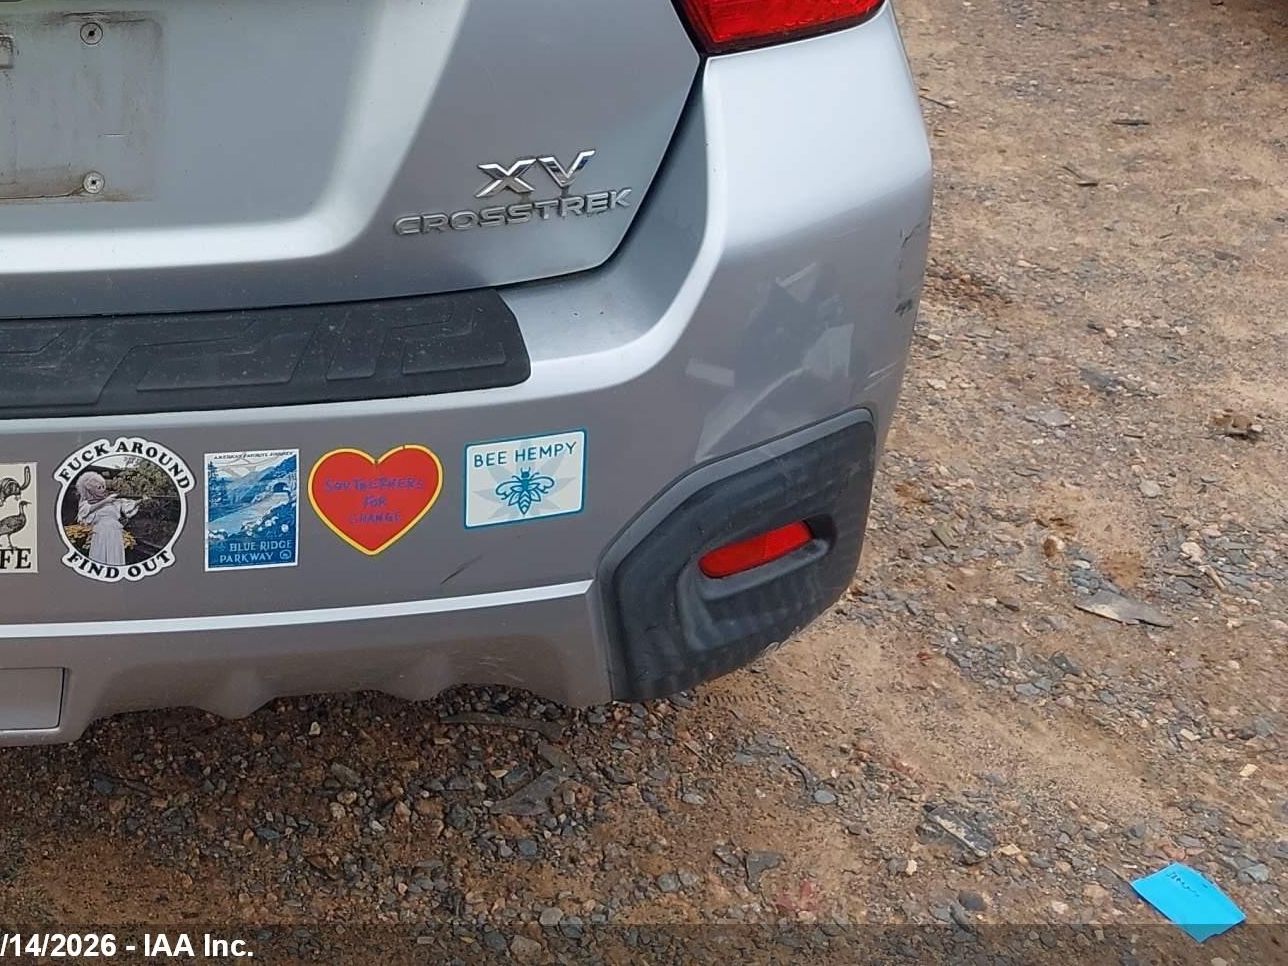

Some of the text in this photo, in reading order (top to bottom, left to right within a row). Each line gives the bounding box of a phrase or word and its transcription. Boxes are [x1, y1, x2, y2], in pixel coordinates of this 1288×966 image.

[475, 149, 596, 198] XV
[394, 188, 632, 235] CROSSTREK
[58, 441, 190, 489] FUCK AROUND
[474, 441, 576, 467] BEE HEMPY
[220, 552, 274, 563] PARKWAY
[229, 540, 292, 552] BLUE RIDGE
[67, 550, 171, 578] FIND OUT
